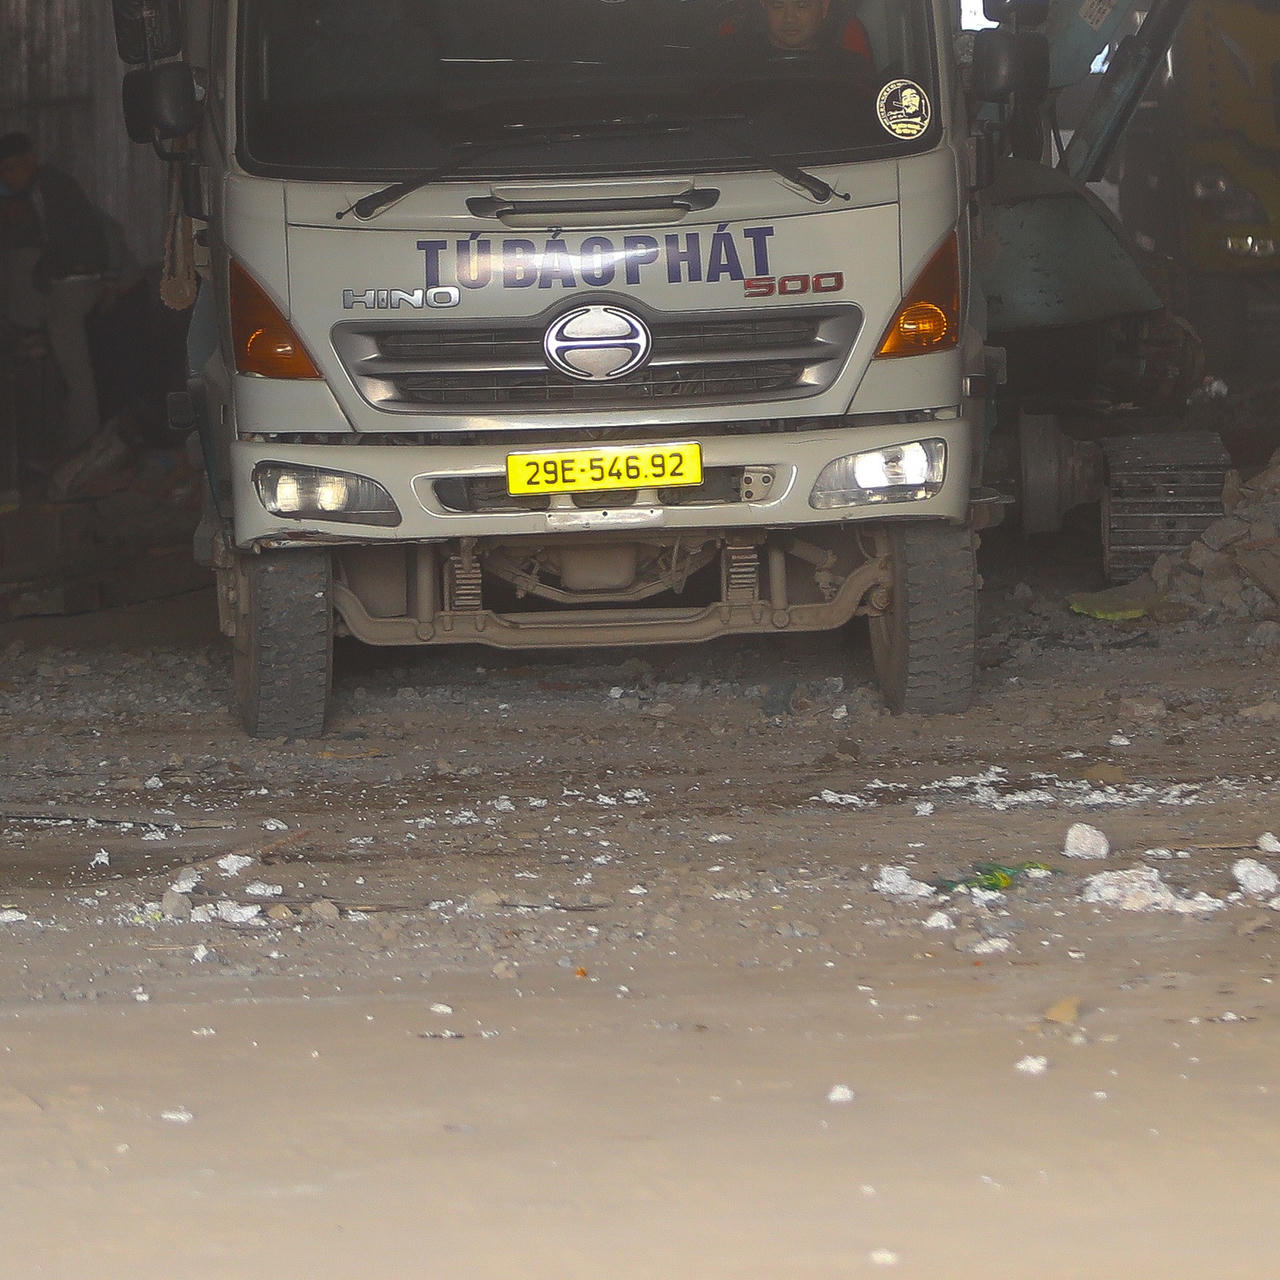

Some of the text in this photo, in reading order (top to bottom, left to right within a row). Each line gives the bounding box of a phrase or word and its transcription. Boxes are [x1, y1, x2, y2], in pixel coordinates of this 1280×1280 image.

[623, 222, 776, 287] PHÁT
[342, 285, 461, 310] HINO
[743, 271, 845, 299] 500
[524, 452, 686, 487] 29E-546.92
